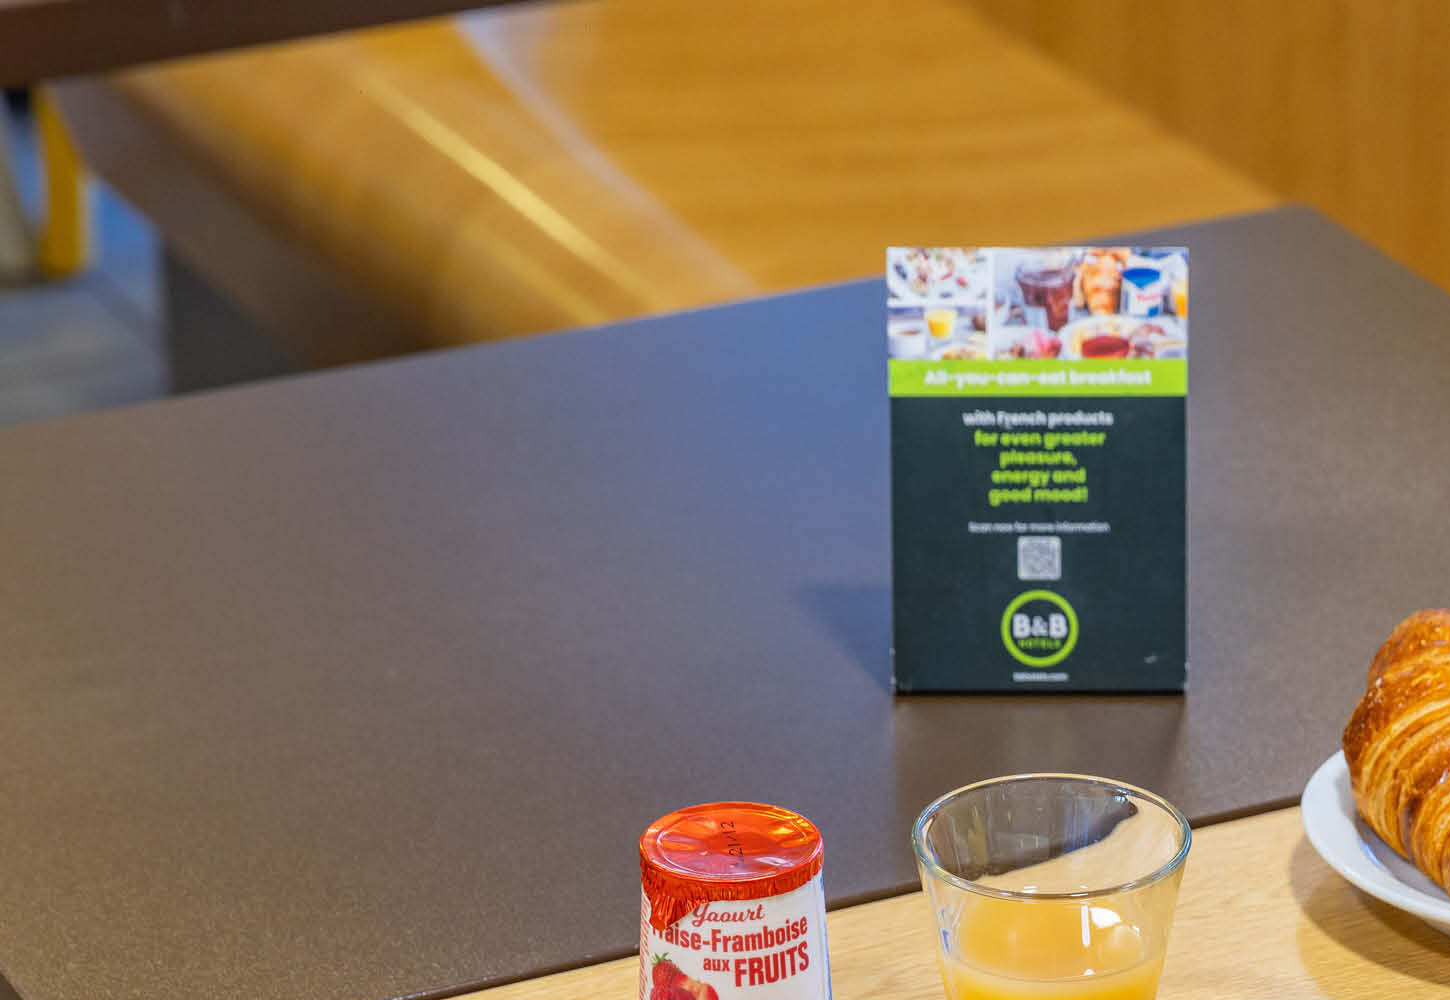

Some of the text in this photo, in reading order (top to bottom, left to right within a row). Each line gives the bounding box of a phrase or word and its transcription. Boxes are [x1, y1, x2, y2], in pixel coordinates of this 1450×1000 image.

[924, 369, 1152, 390] All-you-can-eat breakfast
[962, 410, 1114, 429] with French products
[974, 429, 1106, 450] for even greater
[1000, 449, 1077, 469] pleasure,
[991, 467, 1086, 487] energy and
[988, 486, 1089, 507] good mood!
[1013, 613, 1068, 638] B&B
[692, 903, 765, 927] Yaourt
[652, 915, 808, 953] aise-Framboise
[703, 940, 809, 987] aux FRUITS
